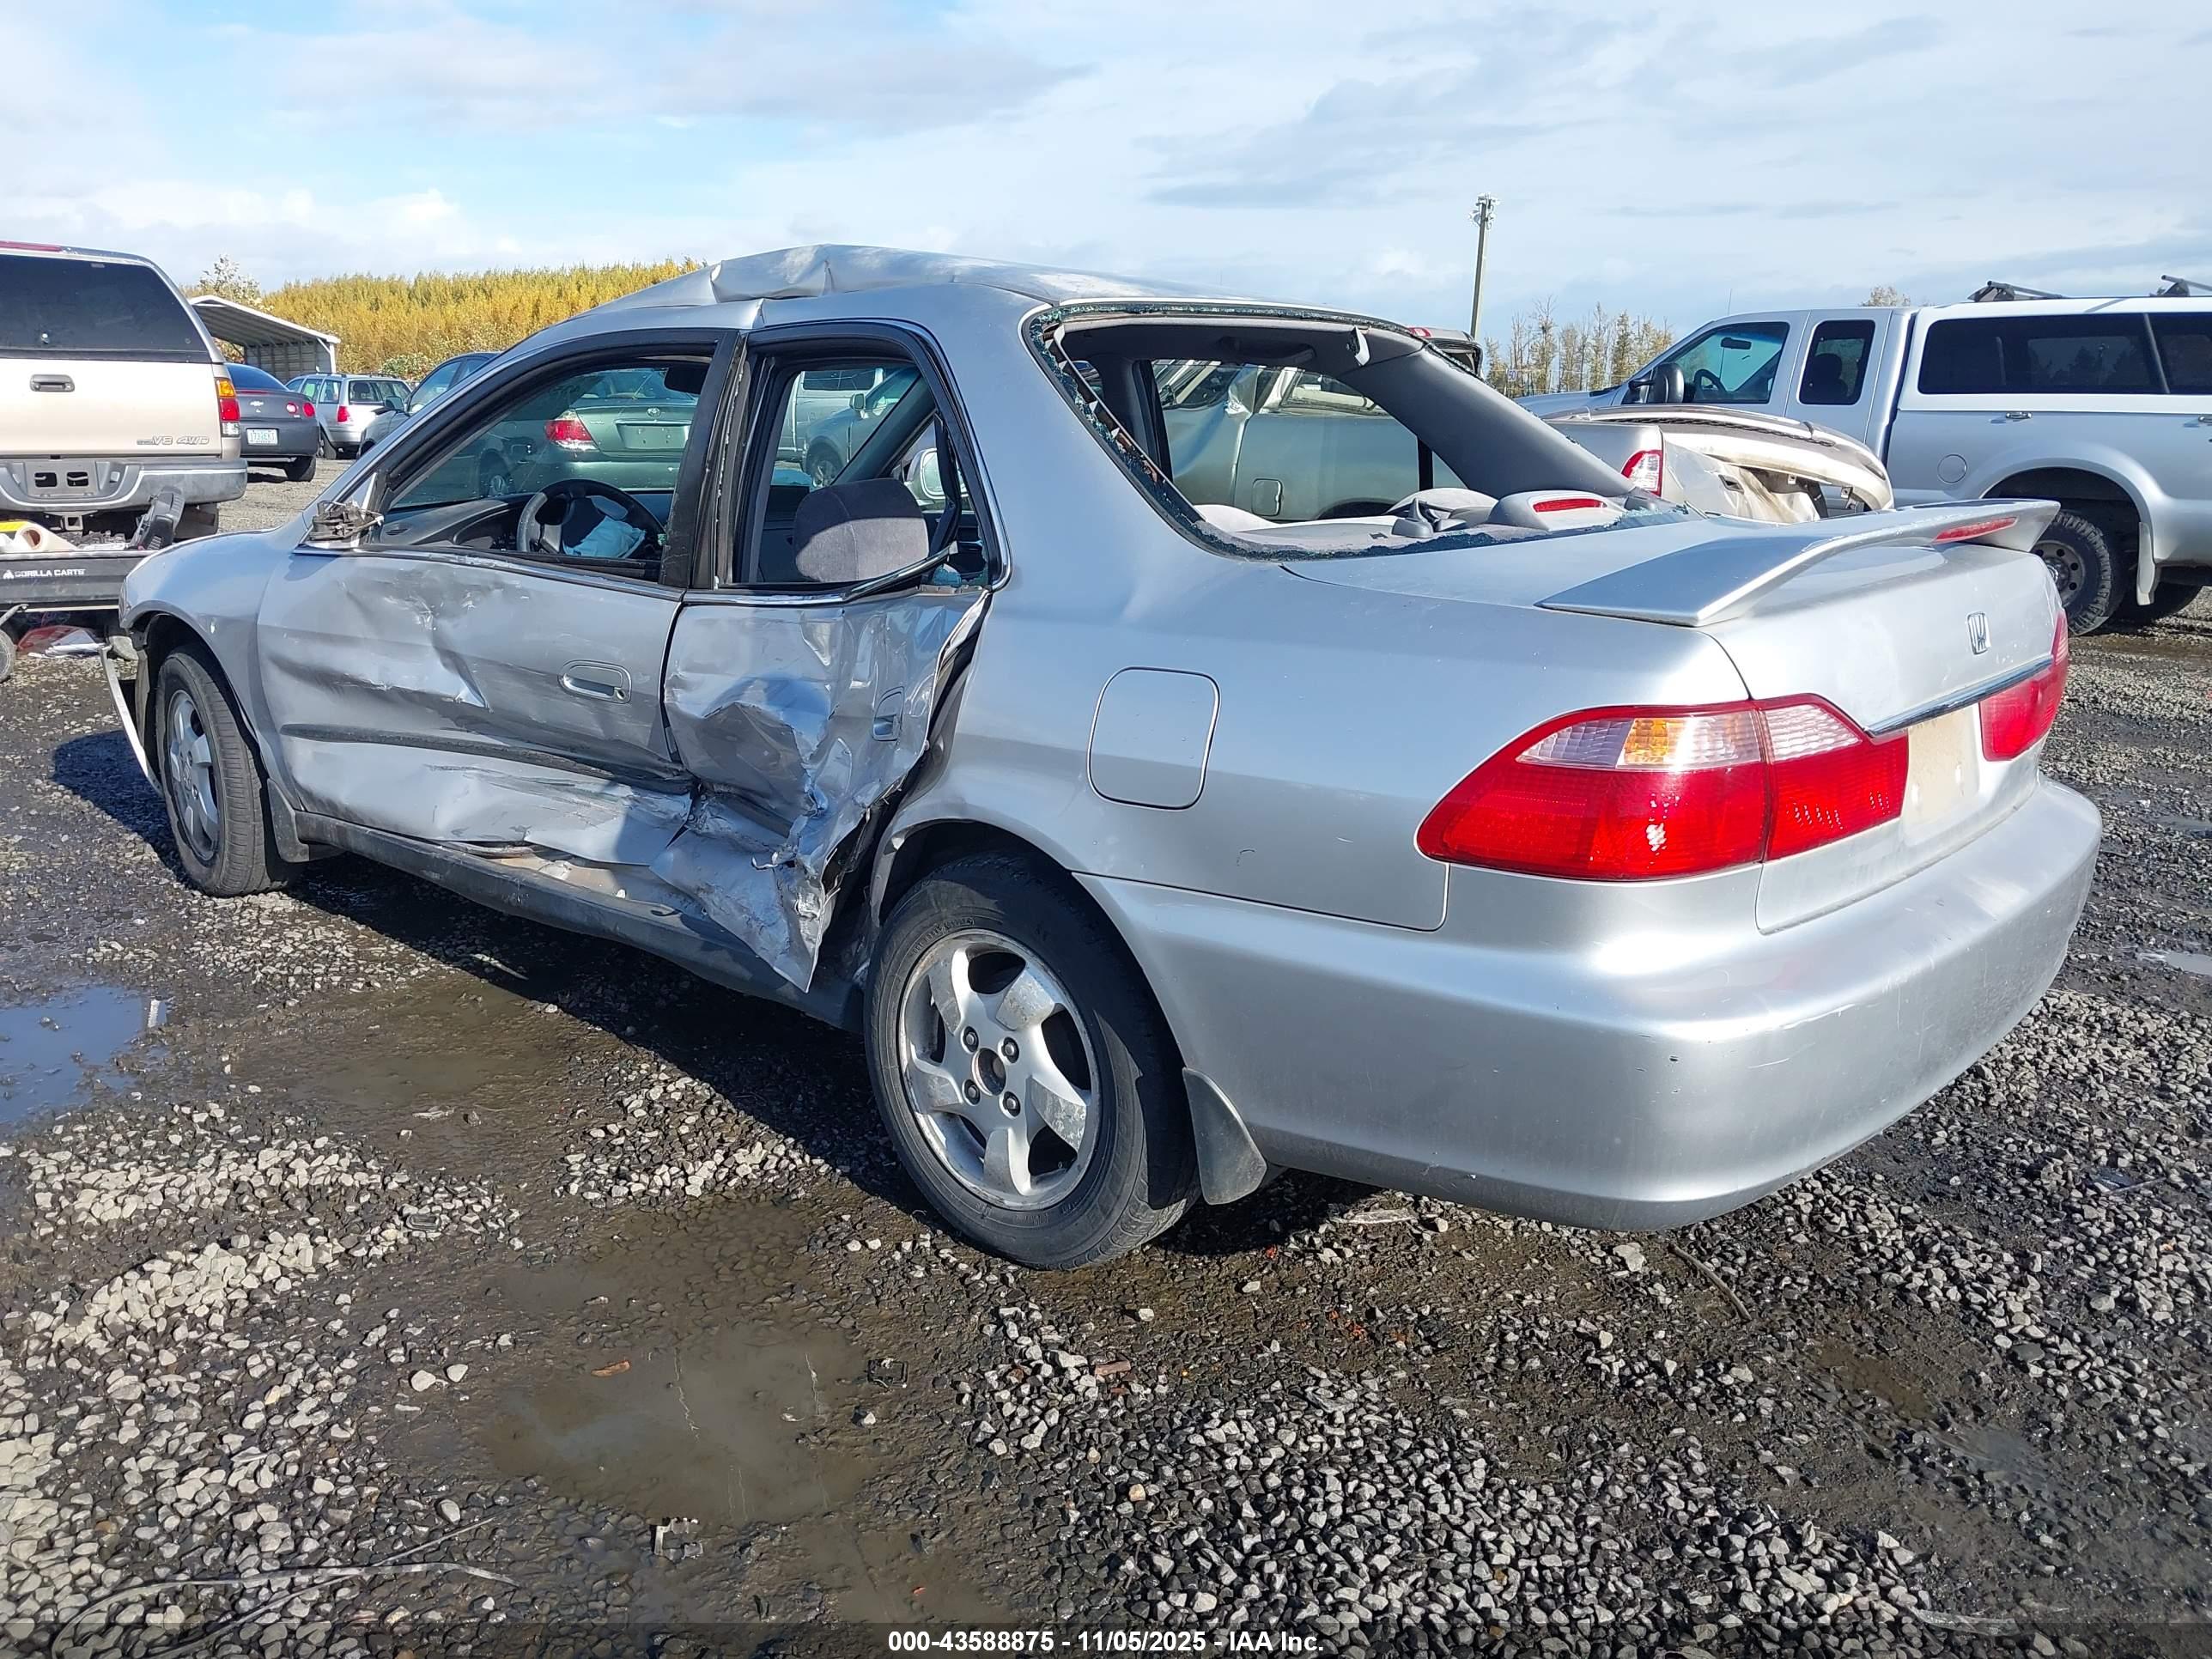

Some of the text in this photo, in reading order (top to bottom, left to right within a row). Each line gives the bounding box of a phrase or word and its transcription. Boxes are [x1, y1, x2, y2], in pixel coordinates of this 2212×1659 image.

[153, 435, 173, 446] V8
[176, 435, 210, 445] 4WD
[15, 569, 52, 578] GORILLA
